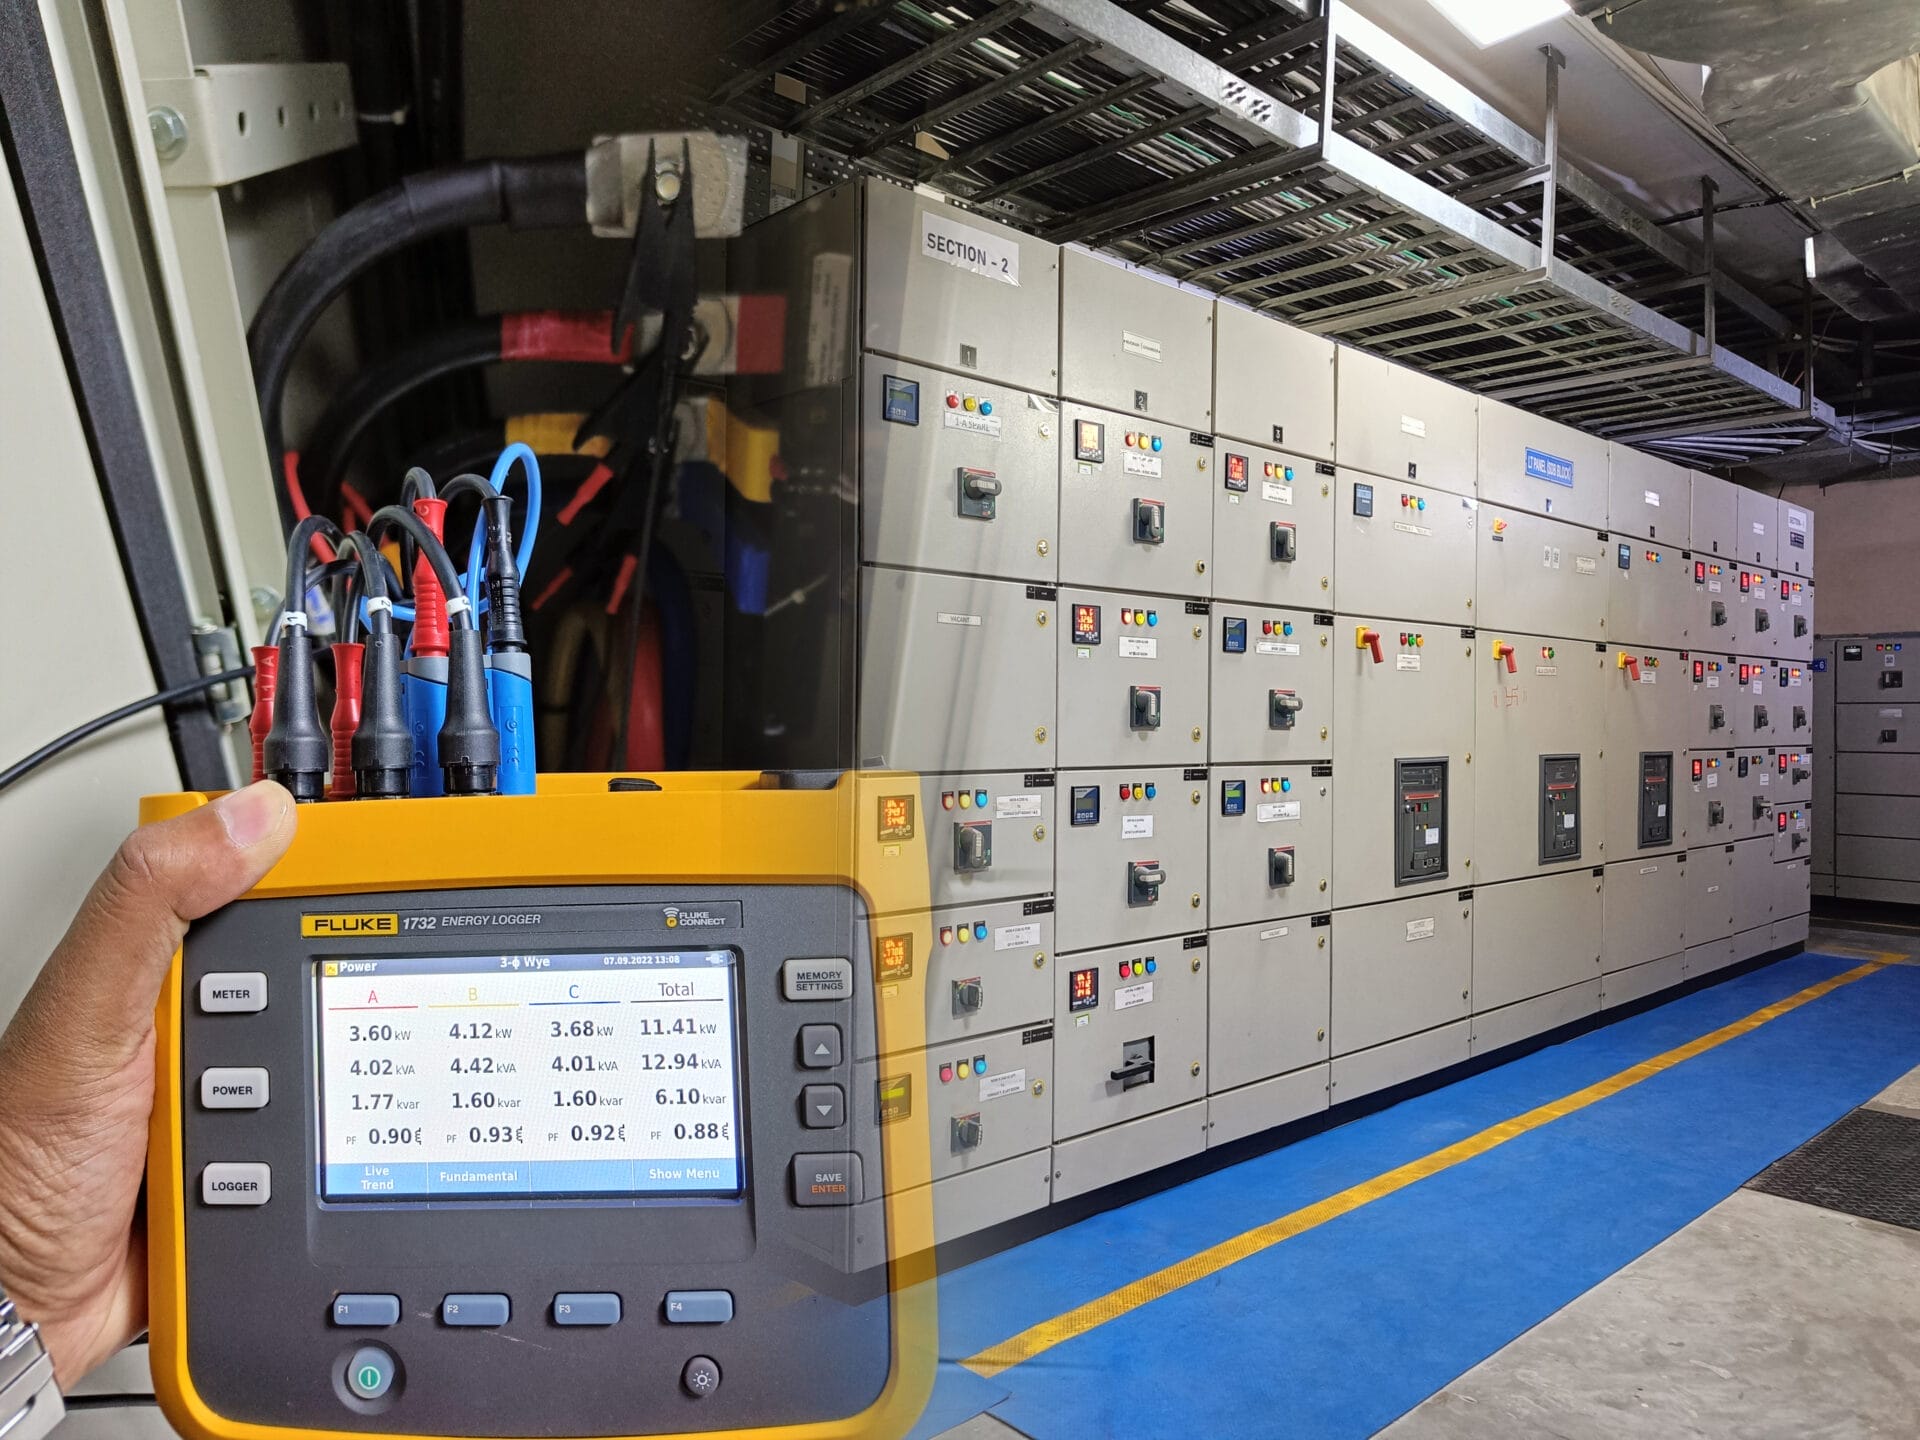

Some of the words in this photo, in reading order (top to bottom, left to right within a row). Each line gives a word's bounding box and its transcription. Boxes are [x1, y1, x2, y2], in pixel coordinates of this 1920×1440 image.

[927, 232, 987, 266] SECTION
[1001, 258, 1008, 273] 2
[402, 916, 436, 930] 1732
[441, 914, 490, 928] ENERGY
[492, 914, 541, 925] LOGGER
[679, 912, 710, 920] FLUKE
[679, 918, 726, 926] CONNECT
[314, 918, 392, 931] FLUKE
[340, 960, 378, 974] Power
[524, 956, 550, 969] Wye
[603, 956, 653, 966] 07.09.2022
[655, 955, 680, 965] 13:08
[796, 970, 842, 981] MEMORY
[368, 990, 378, 1004] A
[469, 988, 478, 1001] B
[568, 985, 579, 999] C
[658, 982, 695, 998] Total
[796, 982, 844, 992] SETTINGS
[212, 989, 250, 1000] METER
[349, 1026, 392, 1042] 3.60
[395, 1030, 411, 1042] kW
[449, 1023, 493, 1040] 4.12
[496, 1028, 512, 1039] kW
[550, 1022, 594, 1038] 3.68
[597, 1026, 614, 1037] kW
[640, 1018, 696, 1036] 11.41
[700, 1023, 716, 1035] kW
[350, 1060, 392, 1076] 4.02
[396, 1063, 415, 1075] kVA
[450, 1058, 494, 1074] 4.42
[496, 1062, 516, 1074] kVA
[552, 1056, 595, 1072] 4.01
[599, 1060, 618, 1072] kVA
[642, 1053, 699, 1071] 12.94
[701, 1058, 722, 1070] kVA
[212, 1085, 253, 1096] POWER
[352, 1094, 394, 1110] 1.77
[397, 1098, 420, 1110] kvar
[452, 1092, 495, 1108] 1.60
[498, 1097, 521, 1108] kvar
[553, 1090, 597, 1107] 1.60
[600, 1095, 623, 1106] kvar
[655, 1088, 700, 1105] 6.10
[703, 1093, 726, 1105] kvar
[346, 1136, 357, 1145] PF
[369, 1128, 412, 1145] 0.90
[446, 1134, 457, 1144] PF
[469, 1127, 512, 1144] 0.93
[548, 1132, 559, 1142] PF
[571, 1125, 616, 1142] 0.92
[651, 1131, 662, 1140] PF
[674, 1123, 719, 1140] 0.88
[365, 1165, 390, 1177] Live
[440, 1170, 518, 1182] Fundamental
[649, 1168, 682, 1180] Show
[686, 1167, 720, 1180] Menu
[815, 1173, 842, 1182] SAVE
[212, 1180, 258, 1192] LOGGER
[361, 1179, 394, 1191] Trend
[811, 1184, 846, 1193] ENTER
[338, 1305, 348, 1314] F1
[447, 1304, 458, 1314] F2
[559, 1304, 570, 1314] F3
[670, 1302, 682, 1312] F4
